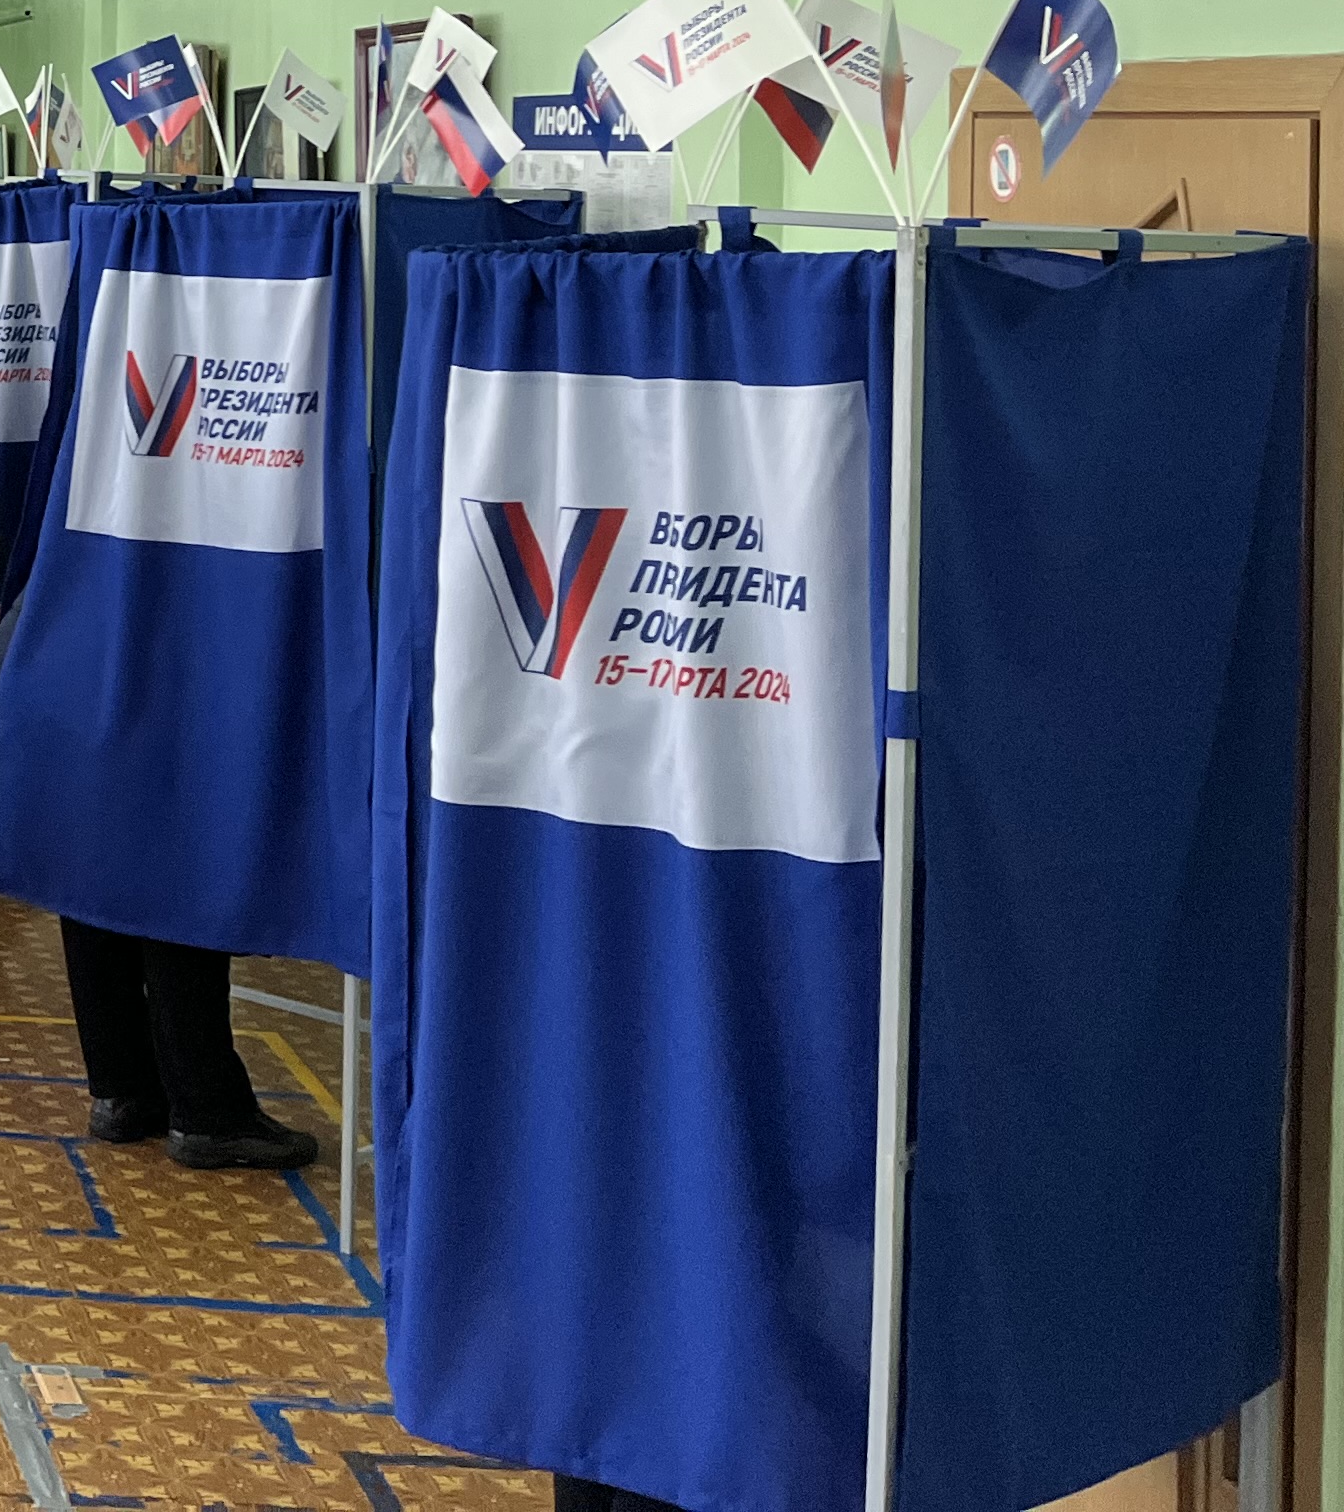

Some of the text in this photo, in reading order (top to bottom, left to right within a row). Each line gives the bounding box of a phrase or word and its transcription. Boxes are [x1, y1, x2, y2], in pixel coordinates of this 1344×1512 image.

[201, 358, 289, 384] ВЫБОРЫ
[215, 446, 266, 467] МАРТА
[267, 449, 304, 468] 2024
[733, 667, 791, 705] 2024
